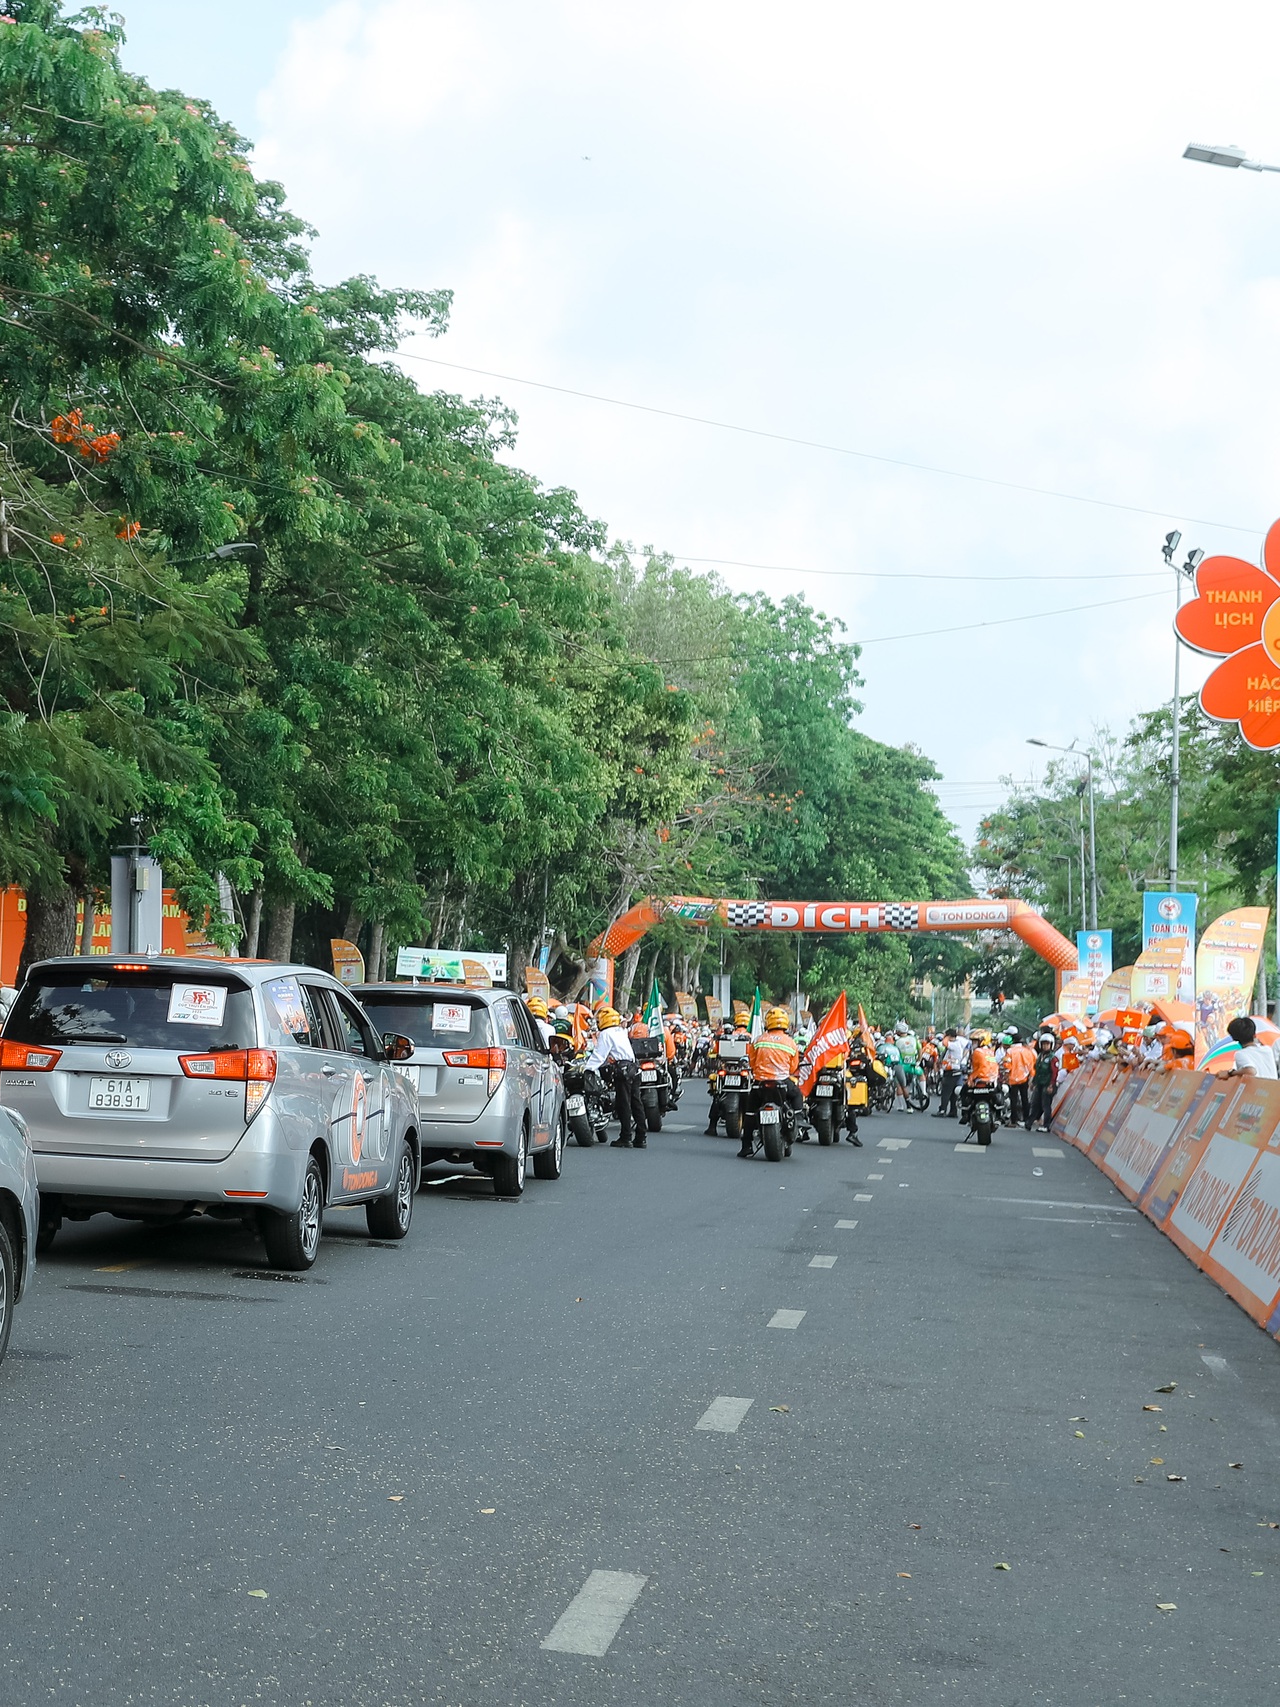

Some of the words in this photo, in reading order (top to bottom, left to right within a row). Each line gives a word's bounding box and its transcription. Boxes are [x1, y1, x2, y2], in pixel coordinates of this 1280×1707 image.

[1206, 590, 1262, 604] THANH
[1214, 612, 1254, 629] LỊCH
[771, 904, 880, 928] ĐÍCH
[941, 912, 963, 921] TON
[965, 911, 996, 920] DONG
[107, 1080, 132, 1093] 61A
[95, 1094, 141, 1108] 838.91
